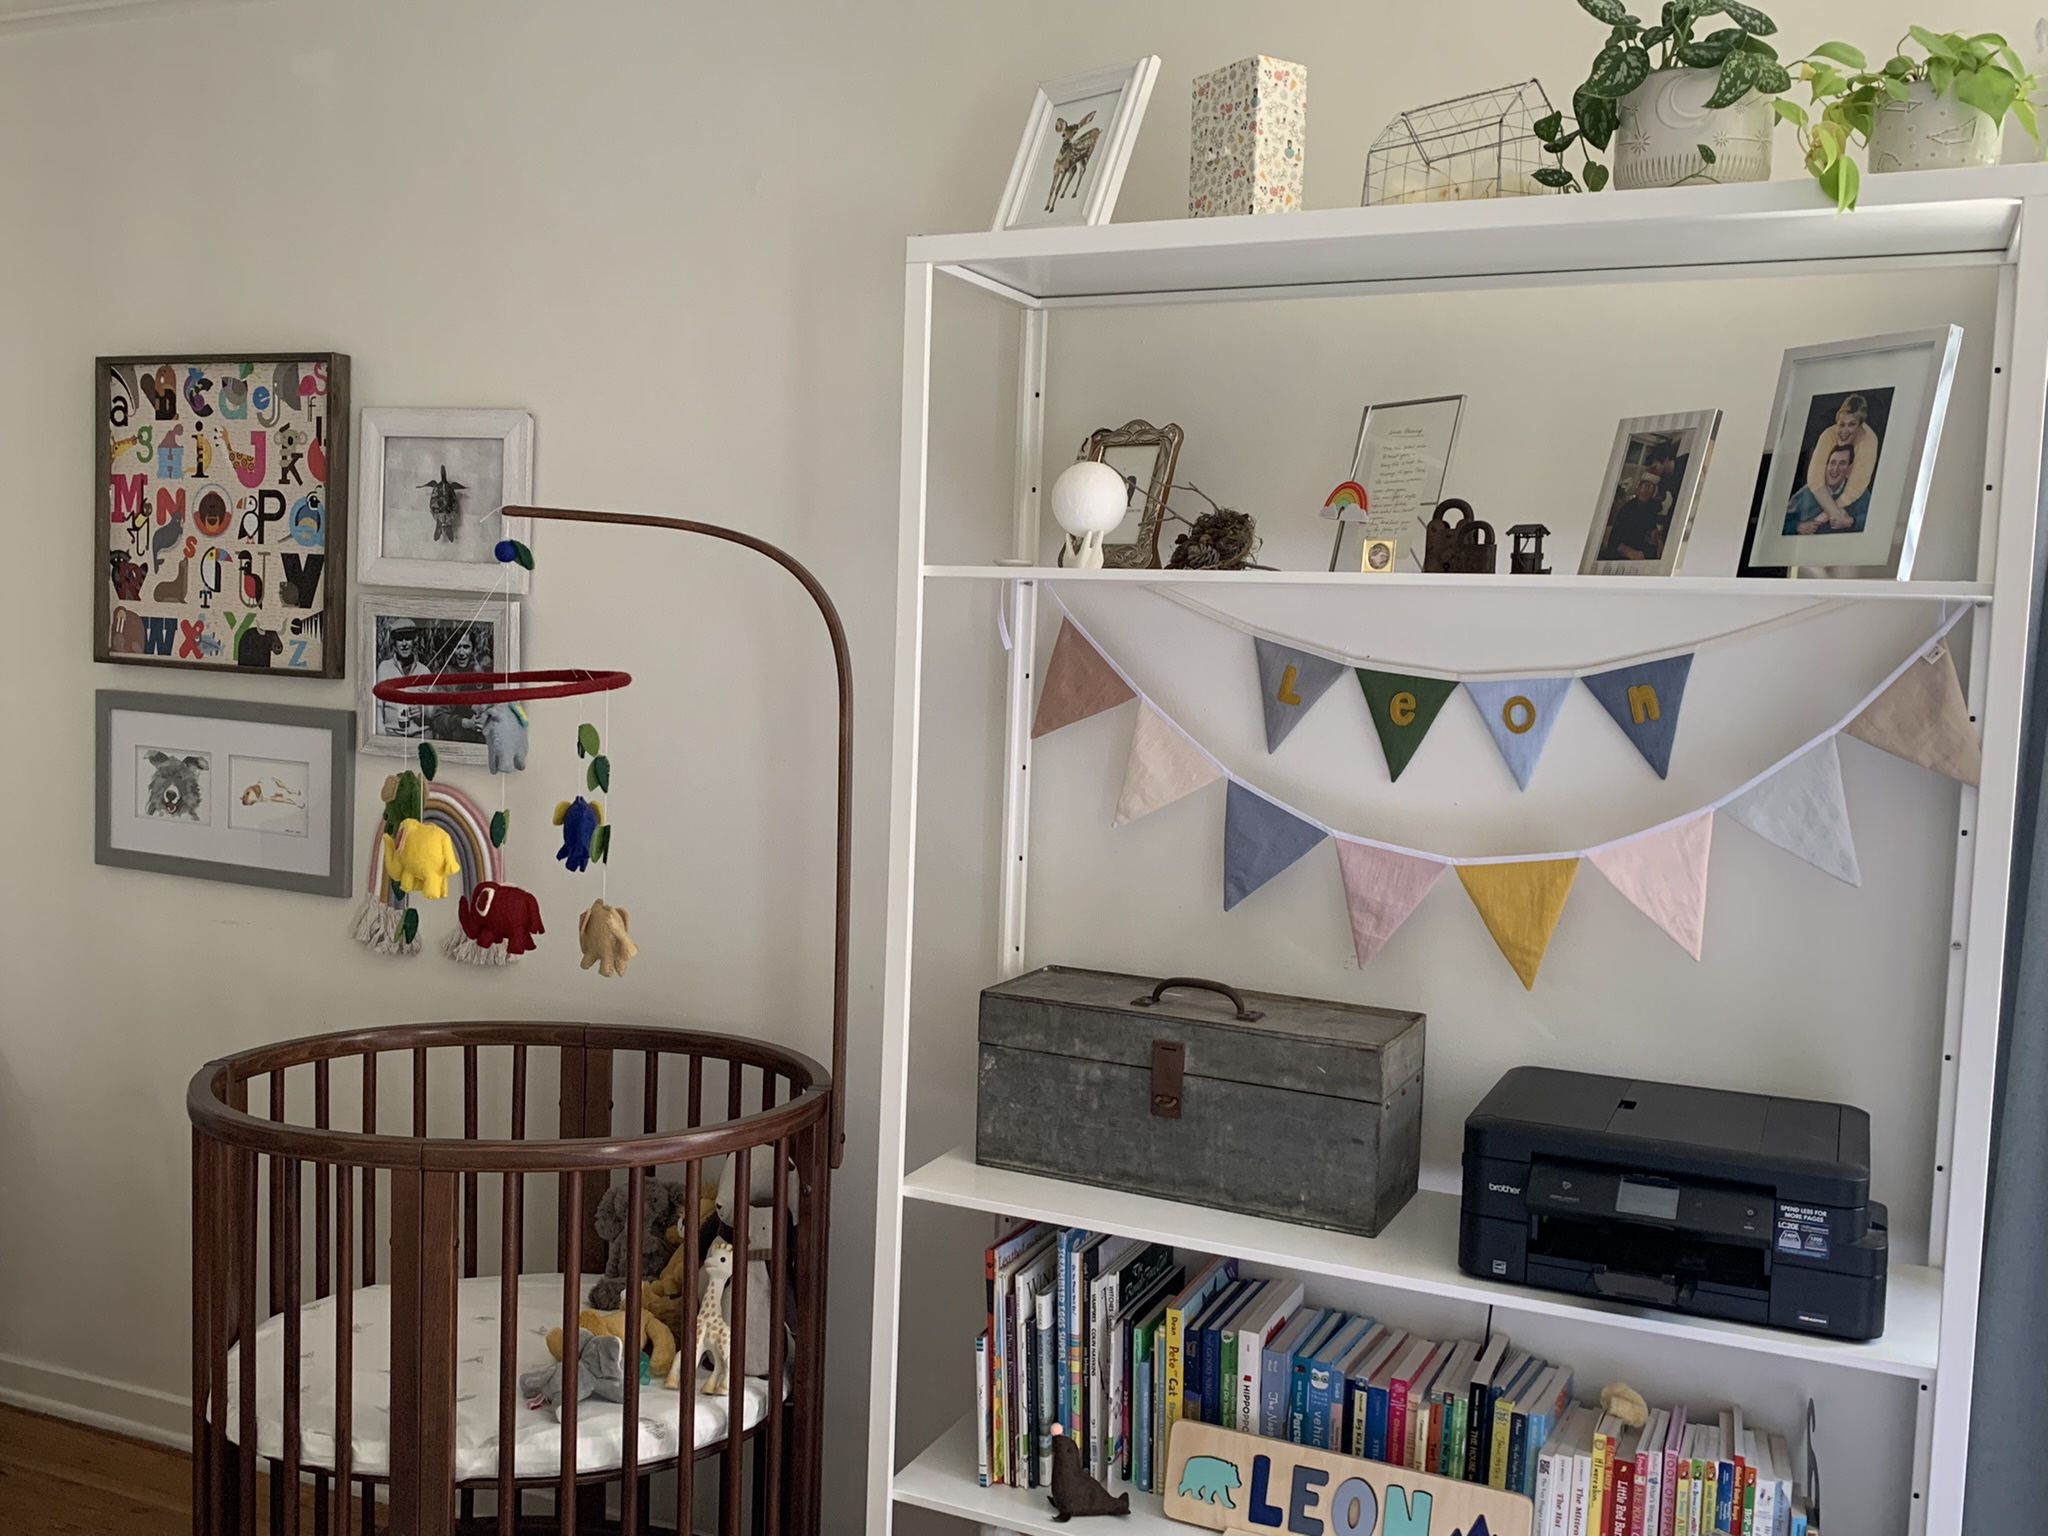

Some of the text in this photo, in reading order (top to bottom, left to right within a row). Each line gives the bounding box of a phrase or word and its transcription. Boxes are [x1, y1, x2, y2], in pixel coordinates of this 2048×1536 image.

[252, 386, 271, 411] e
[111, 474, 149, 524] M
[257, 489, 288, 545] P
[184, 535, 198, 559] S
[280, 552, 325, 609] V
[179, 618, 205, 660] X
[288, 639, 312, 667] Z
[1488, 1182, 1521, 1195] brother
[1780, 1204, 1800, 1213] SPEND
[1784, 1212, 1825, 1223] MORE PAGES
[1057, 1247, 1067, 1303] SCRAMBLED
[1057, 1305, 1067, 1330] EGGS
[1171, 1316, 1179, 1336] Dean
[1057, 1331, 1068, 1364] SUPER!
[1169, 1345, 1180, 1369] Pete
[1168, 1377, 1180, 1397] Cat
[1267, 1391, 1279, 1411] The
[1665, 1453, 1676, 1485] BOOK
[1248, 1454, 1434, 1536] LEON
[1556, 1493, 1565, 1510] The
[1575, 1487, 1584, 1505] The
[1616, 1480, 1628, 1504] Little
[1664, 1488, 1674, 1505] OF
[1554, 1512, 1563, 1529] Hat
[1573, 1506, 1582, 1536] Mitten
[1615, 1504, 1627, 1520] Red
